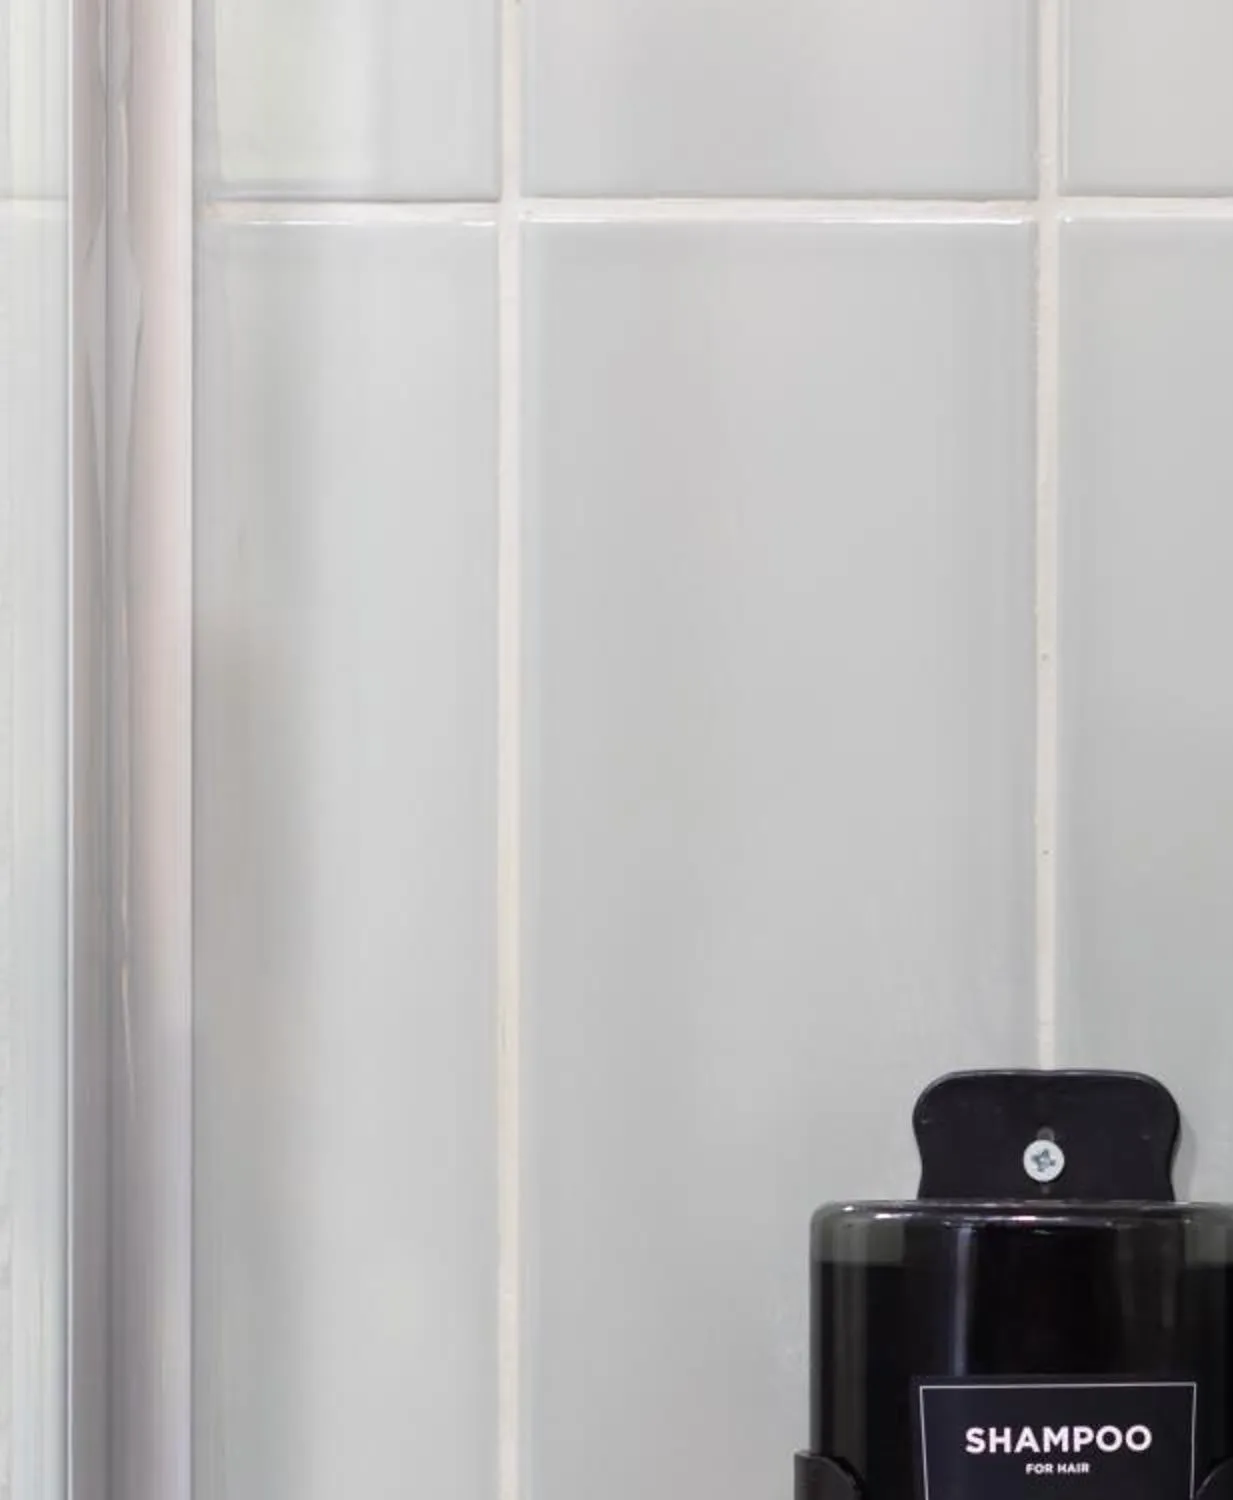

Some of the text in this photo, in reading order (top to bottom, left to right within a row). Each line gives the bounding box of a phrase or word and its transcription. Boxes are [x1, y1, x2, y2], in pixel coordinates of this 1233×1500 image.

[965, 1425, 1152, 1453] SHAMPOO
[1026, 1463, 1090, 1474] FOR HAIR
